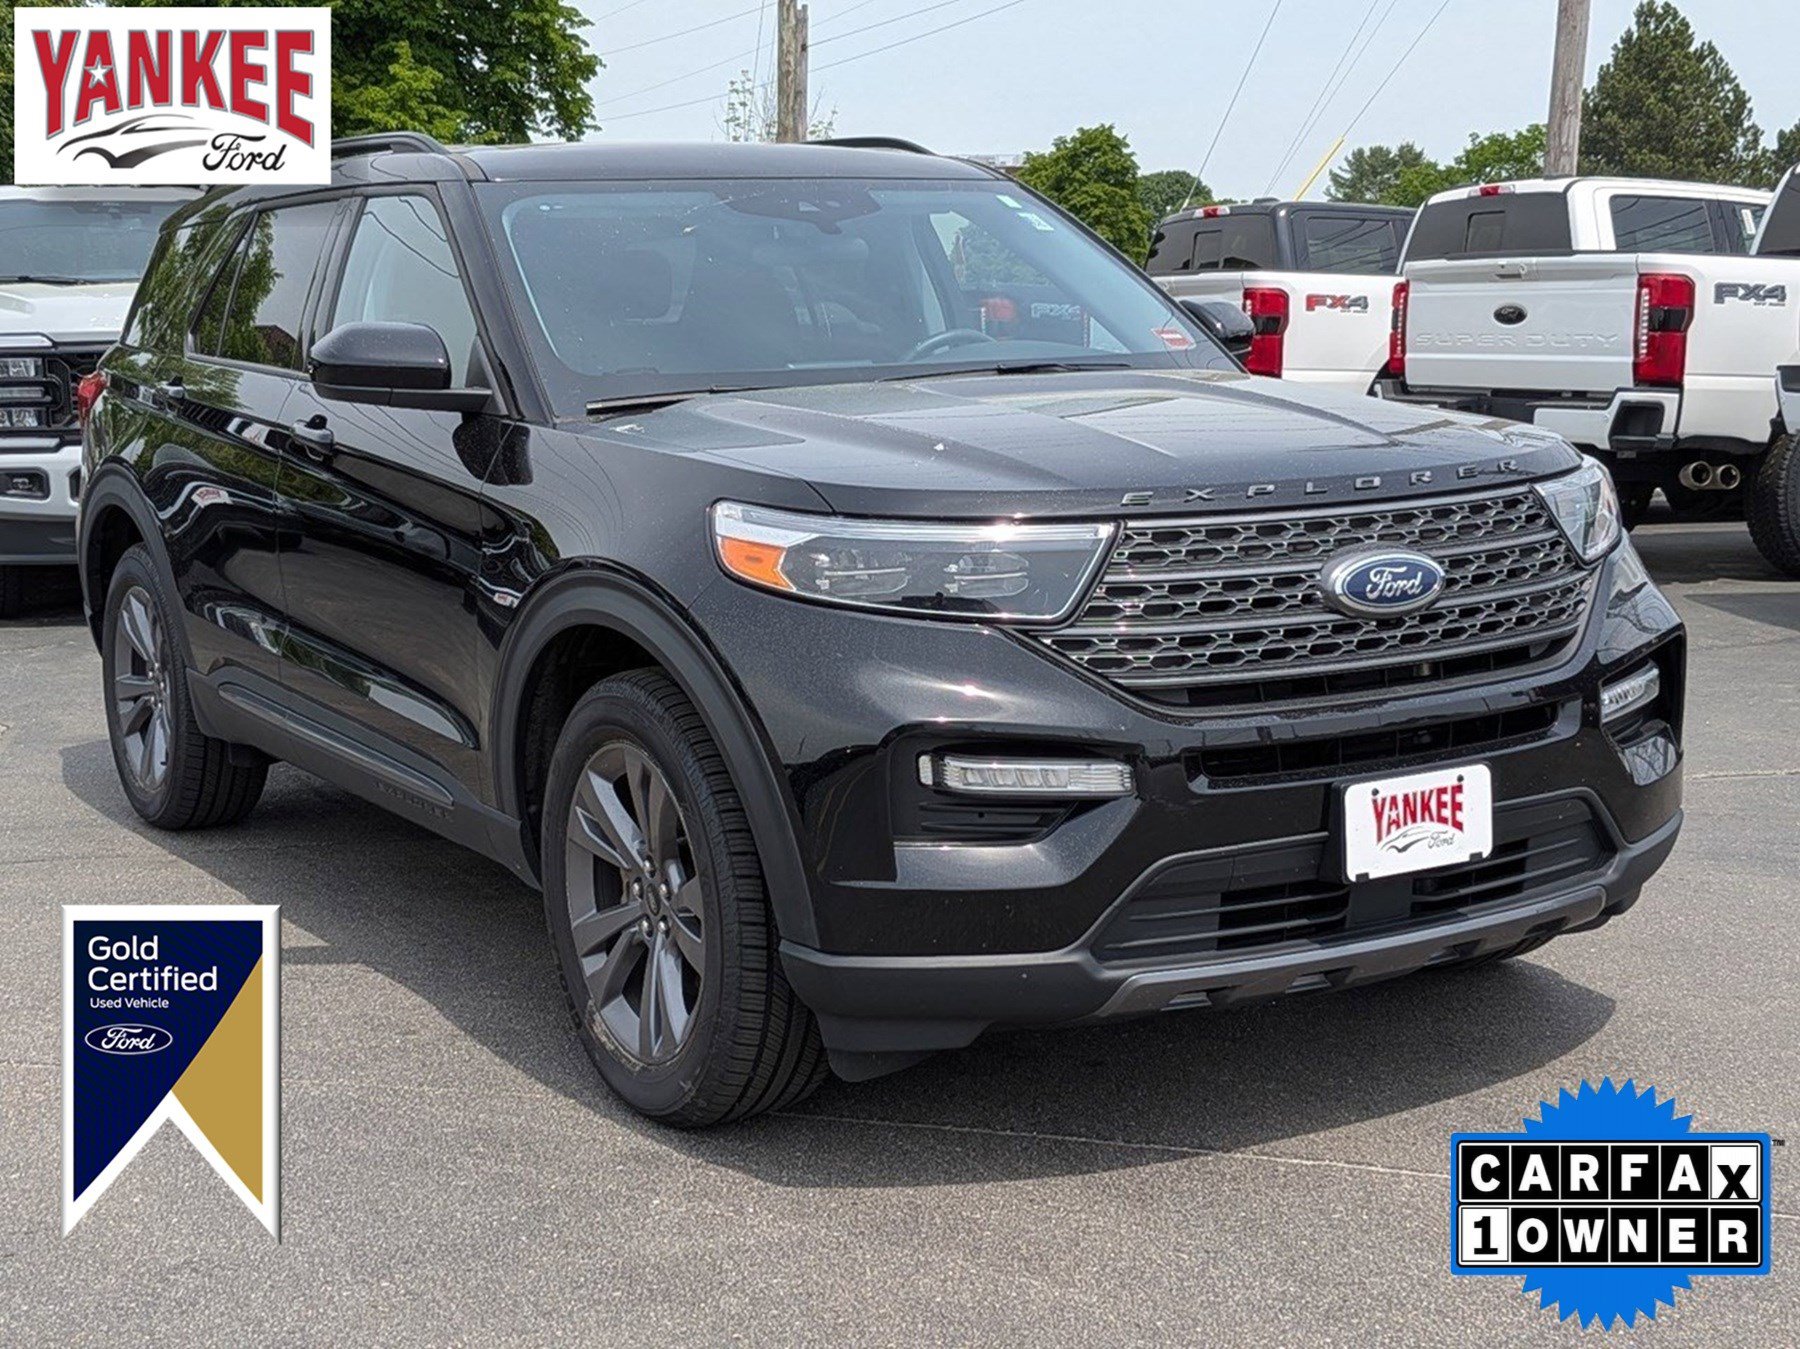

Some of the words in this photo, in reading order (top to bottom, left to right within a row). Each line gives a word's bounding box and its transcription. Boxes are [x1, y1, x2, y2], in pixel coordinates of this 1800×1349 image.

[1306, 293, 1369, 312] FX4
[1714, 282, 1786, 305] FX4
[1415, 333, 1517, 347] SUPER
[1525, 333, 1619, 348] DUTY
[1121, 458, 1521, 506] EXPLORER
[1365, 566, 1423, 601] Ford
[1372, 784, 1464, 844] YANKEE
